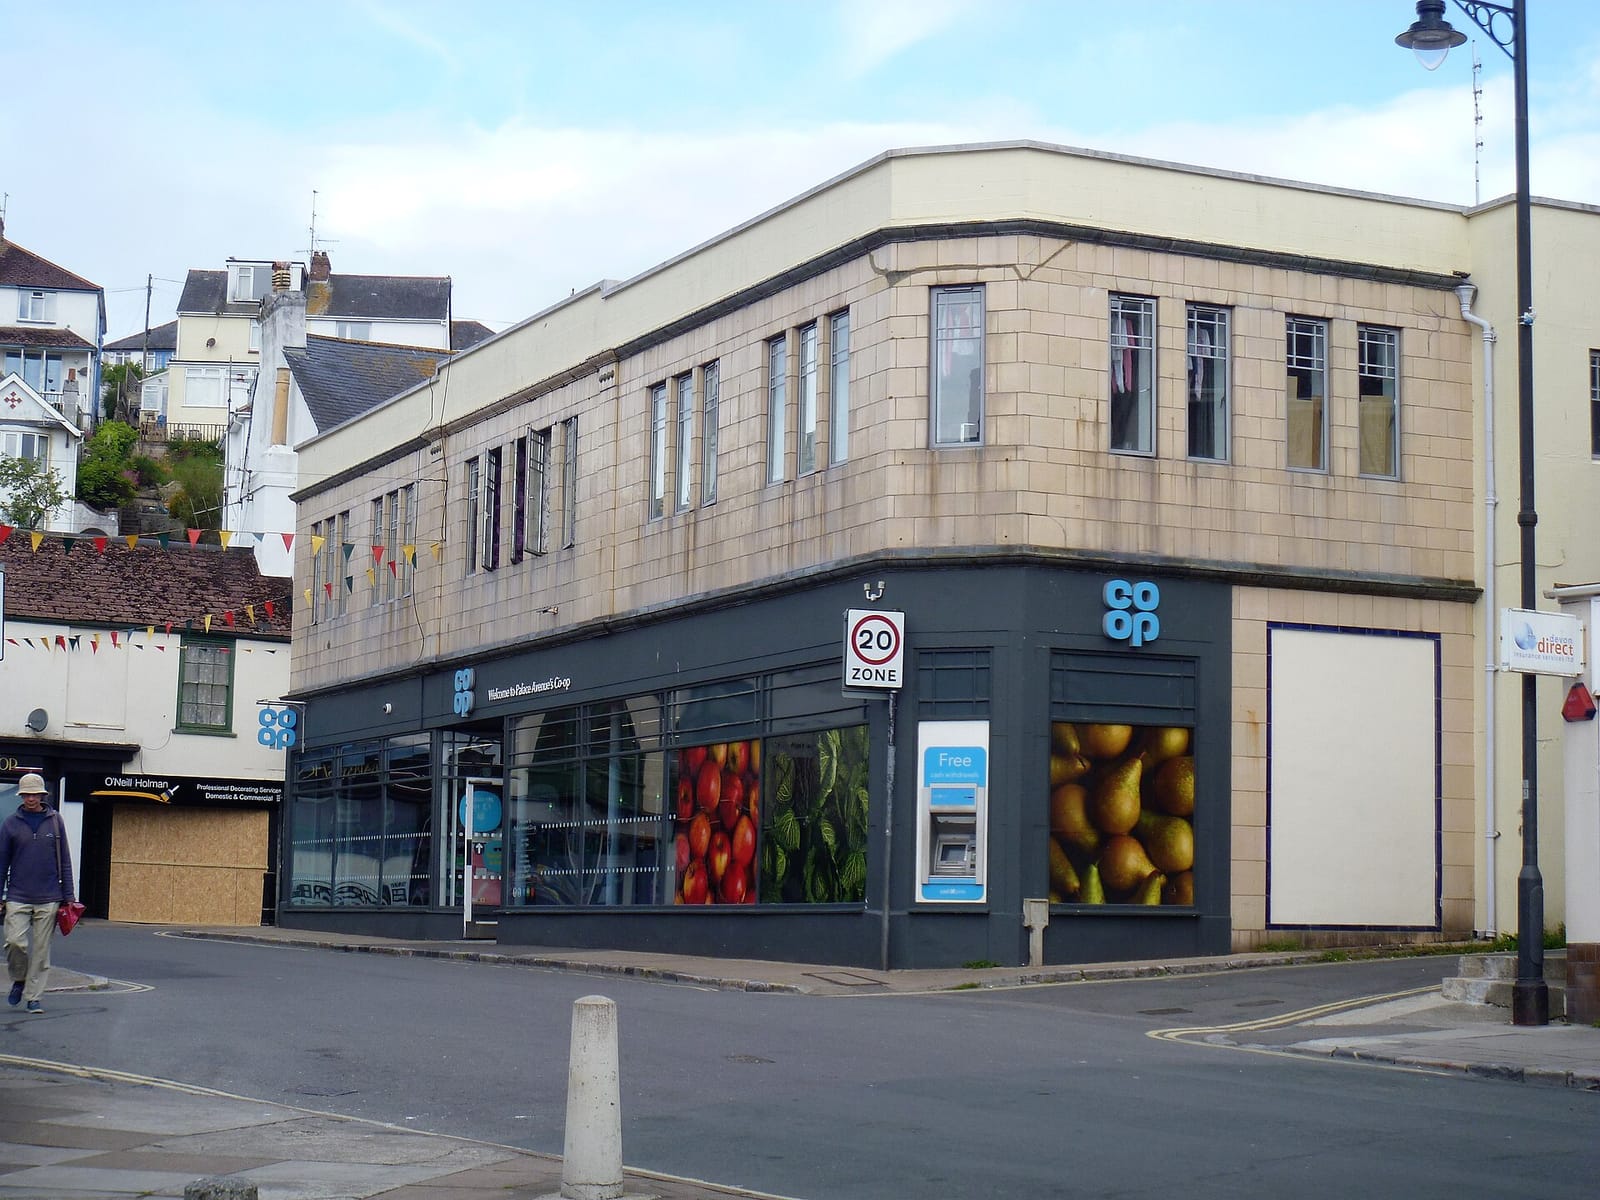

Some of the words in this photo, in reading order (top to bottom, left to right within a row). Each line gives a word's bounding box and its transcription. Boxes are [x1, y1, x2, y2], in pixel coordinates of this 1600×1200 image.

[859, 630, 892, 650] 20
[1538, 637, 1573, 656] direct
[852, 668, 896, 681] ZONE
[488, 687, 510, 701] Welcome
[510, 687, 515, 696] to
[515, 683, 532, 696] Palace
[554, 676, 571, 690] Co-op
[939, 752, 972, 767] Free
[104, 776, 132, 787] O'Neill
[135, 779, 168, 788] Holman
[196, 783, 229, 791] Professional
[230, 785, 259, 794] Decorating
[239, 794, 273, 802] Commercial
